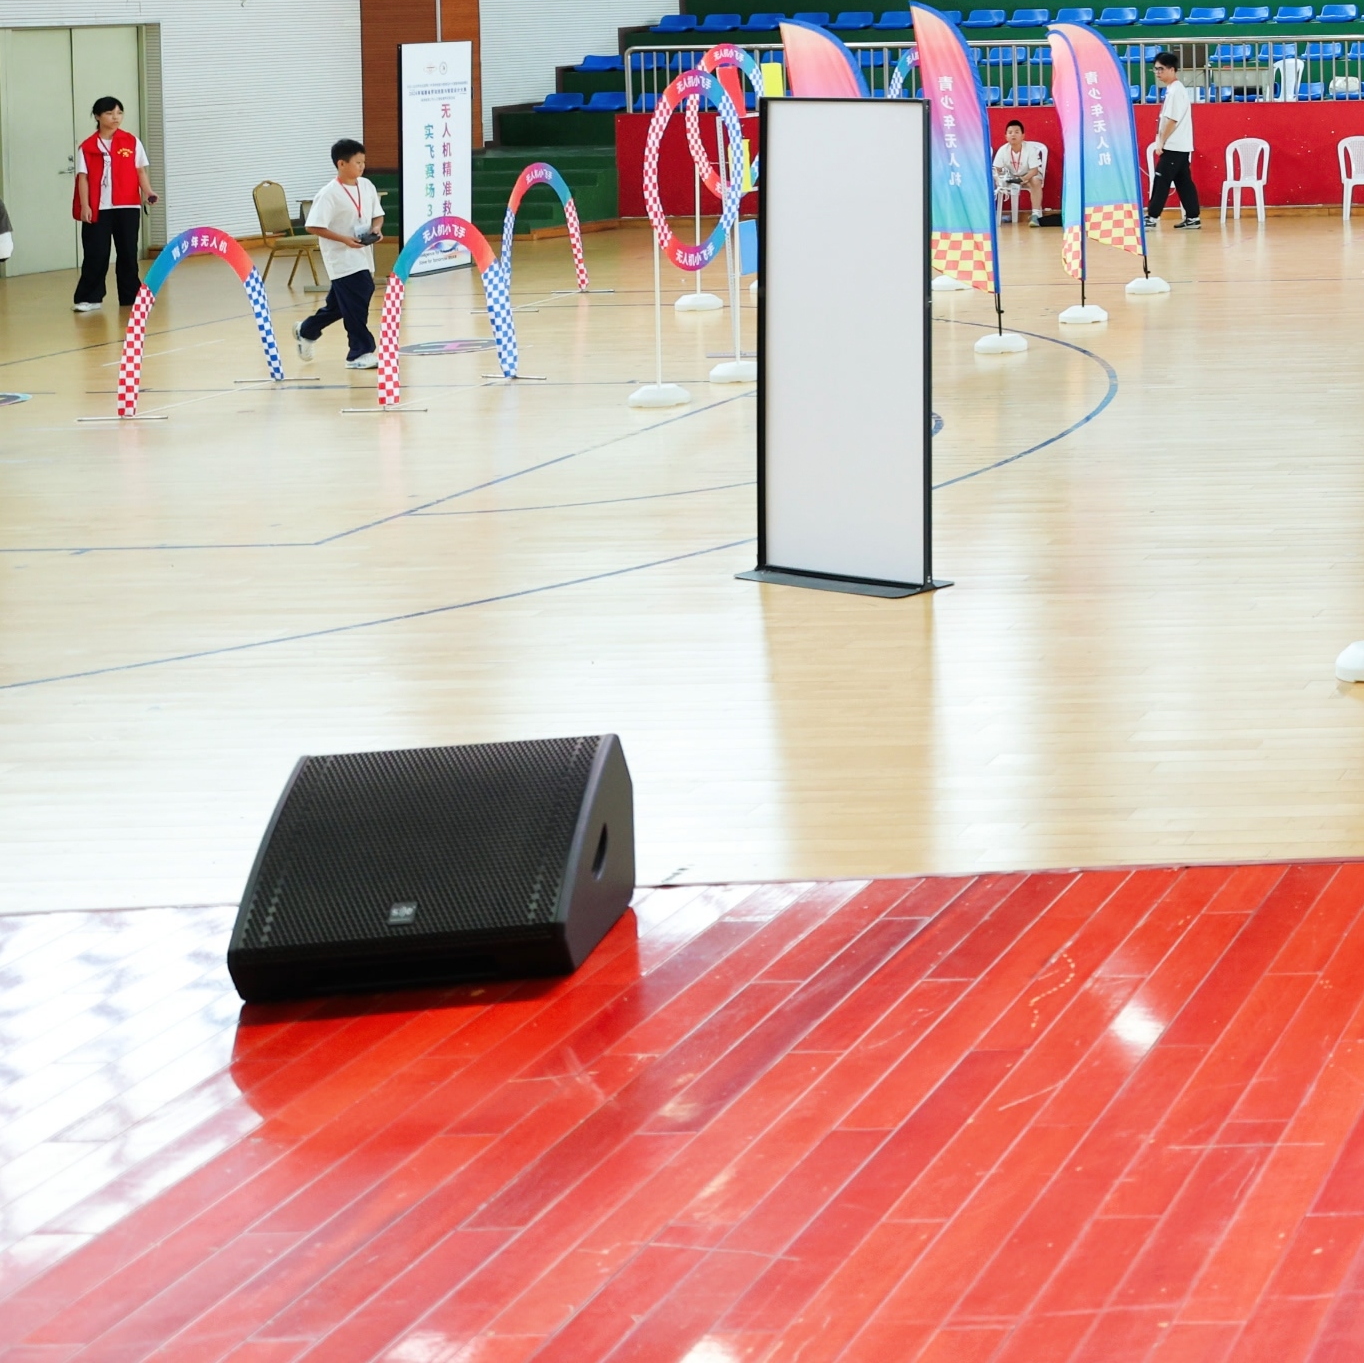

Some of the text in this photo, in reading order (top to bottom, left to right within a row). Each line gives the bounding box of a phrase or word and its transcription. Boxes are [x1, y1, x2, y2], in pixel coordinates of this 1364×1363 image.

[676, 75, 712, 94] 无人机小飞手
[422, 223, 466, 244] 无人机小飞手
[171, 234, 228, 261] 青少年无人机
[675, 242, 715, 266] 无人机小飞手
